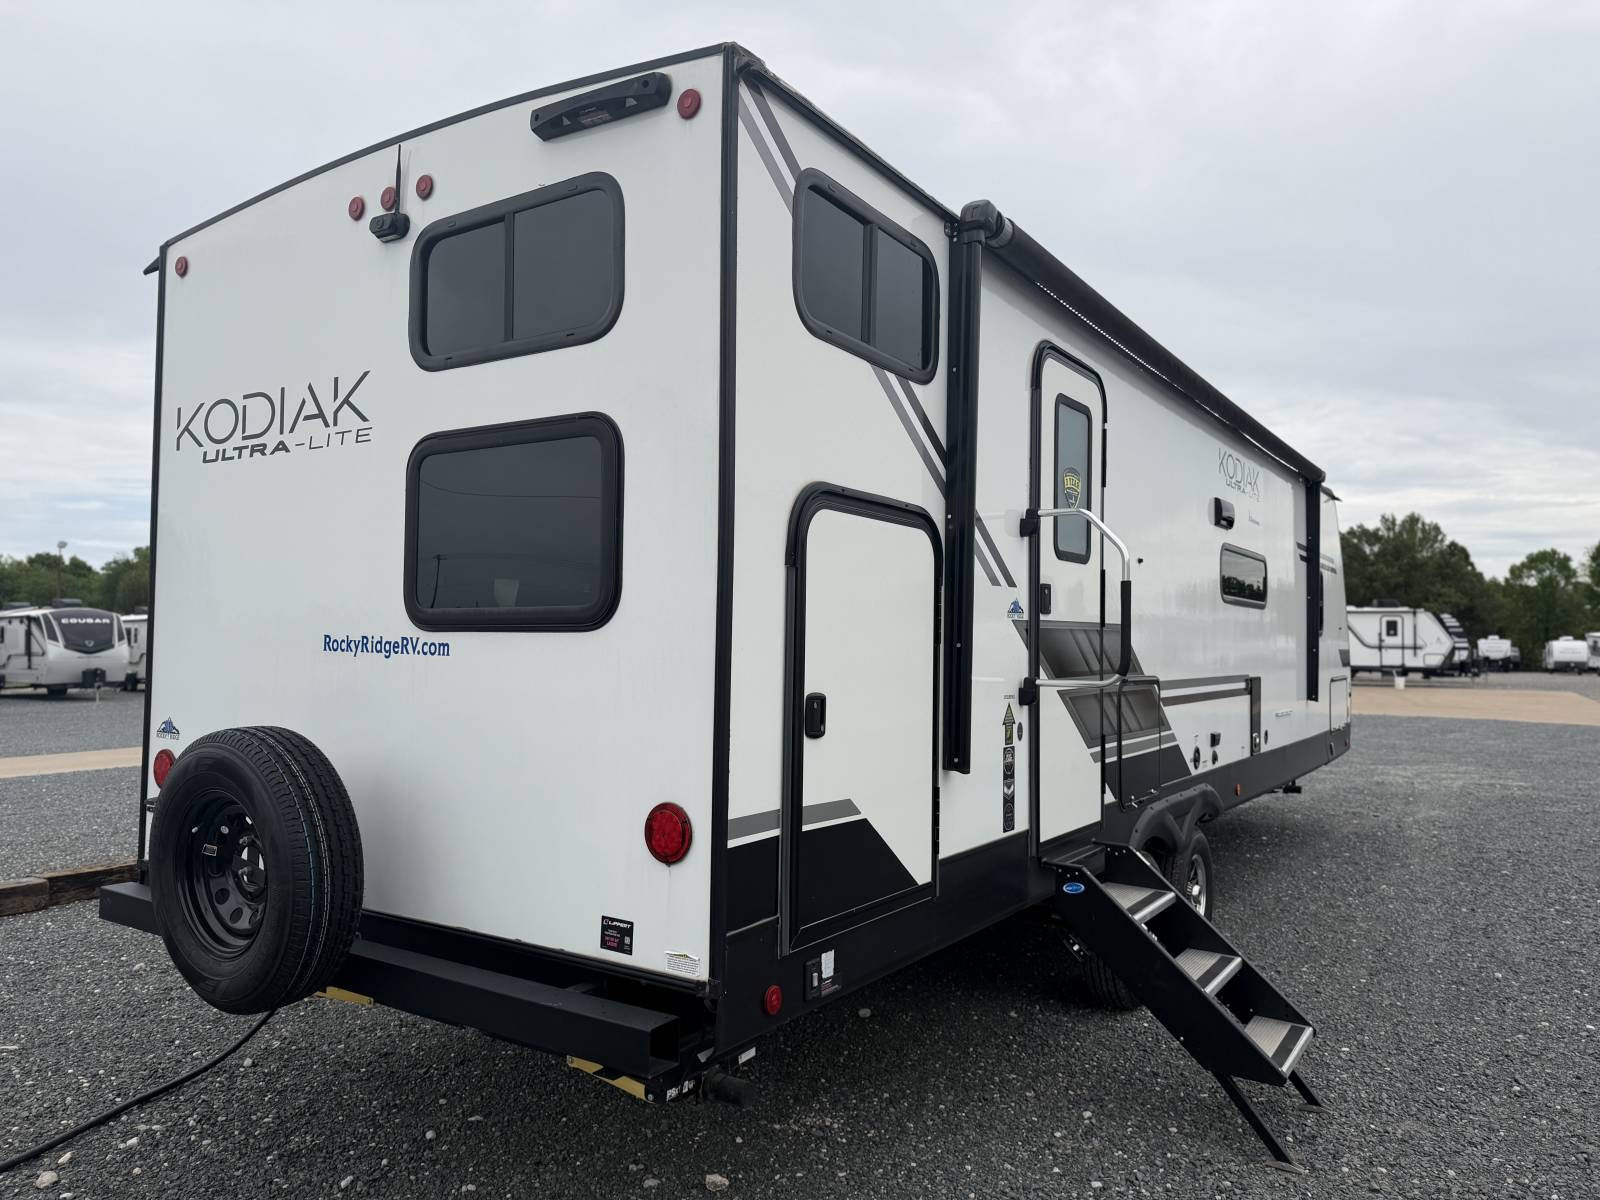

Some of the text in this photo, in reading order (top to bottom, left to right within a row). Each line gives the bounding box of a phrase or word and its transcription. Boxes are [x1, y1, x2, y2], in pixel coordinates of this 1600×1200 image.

[176, 370, 371, 451] KODIAK
[202, 427, 373, 464] ULTRA-LITE
[1218, 447, 1260, 499] KODIAK
[61, 617, 111, 625] COUGAR
[323, 634, 450, 659] RockyRidgeRV.com
